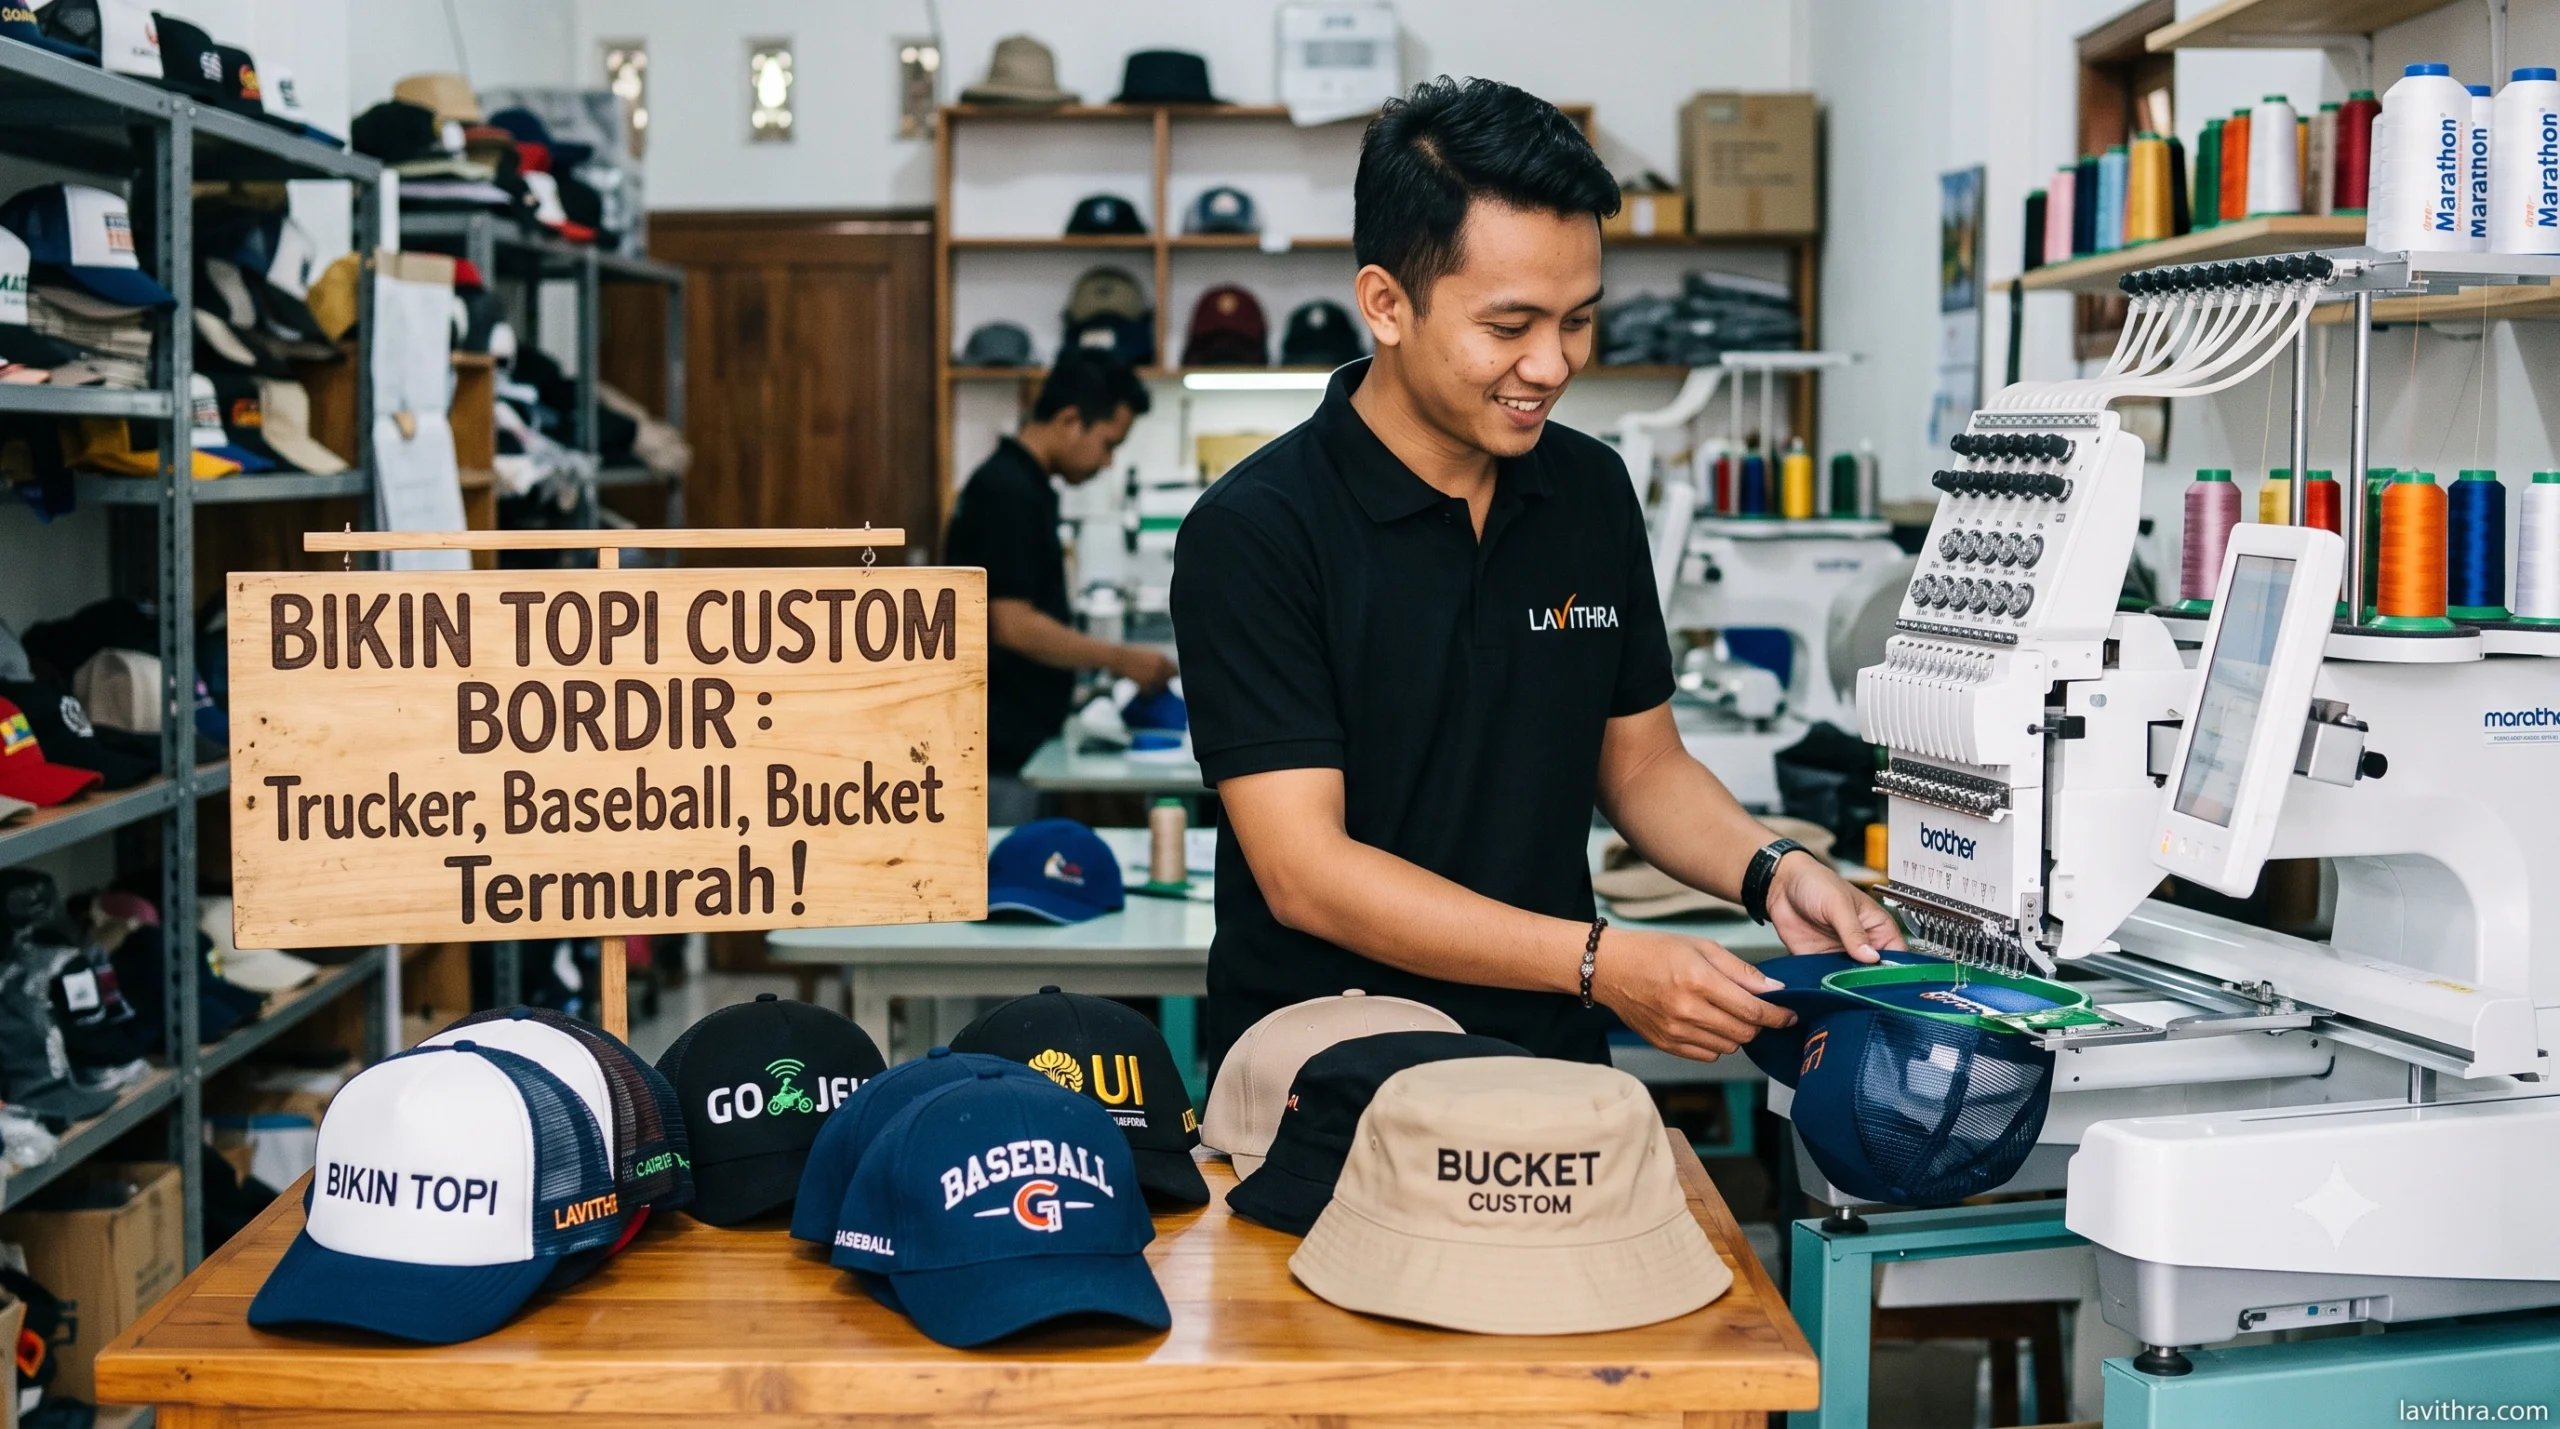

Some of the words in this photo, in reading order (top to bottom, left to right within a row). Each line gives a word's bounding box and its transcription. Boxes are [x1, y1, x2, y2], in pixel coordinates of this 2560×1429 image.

[2435, 119, 2457, 232] Marathon
[2537, 113, 2559, 227] Marathon
[271, 592, 472, 670] BIKIN
[500, 590, 659, 667] TOPI
[686, 588, 957, 665] CUSTOM
[1528, 593, 1619, 631] LAVITHRA
[263, 771, 487, 844] Trucker,
[504, 763, 750, 837] Baseball,
[767, 760, 945, 828] Bucket
[1921, 821, 1977, 861] brother
[707, 1082, 764, 1124] GO
[1092, 1054, 1144, 1106] UI
[326, 1162, 398, 1207] BIKIN
[410, 1174, 498, 1216] TOPI
[940, 1139, 1115, 1211] BASEBALL
[1438, 1147, 1601, 1188] BUCKET
[1468, 1192, 1571, 1214] CUSTOM
